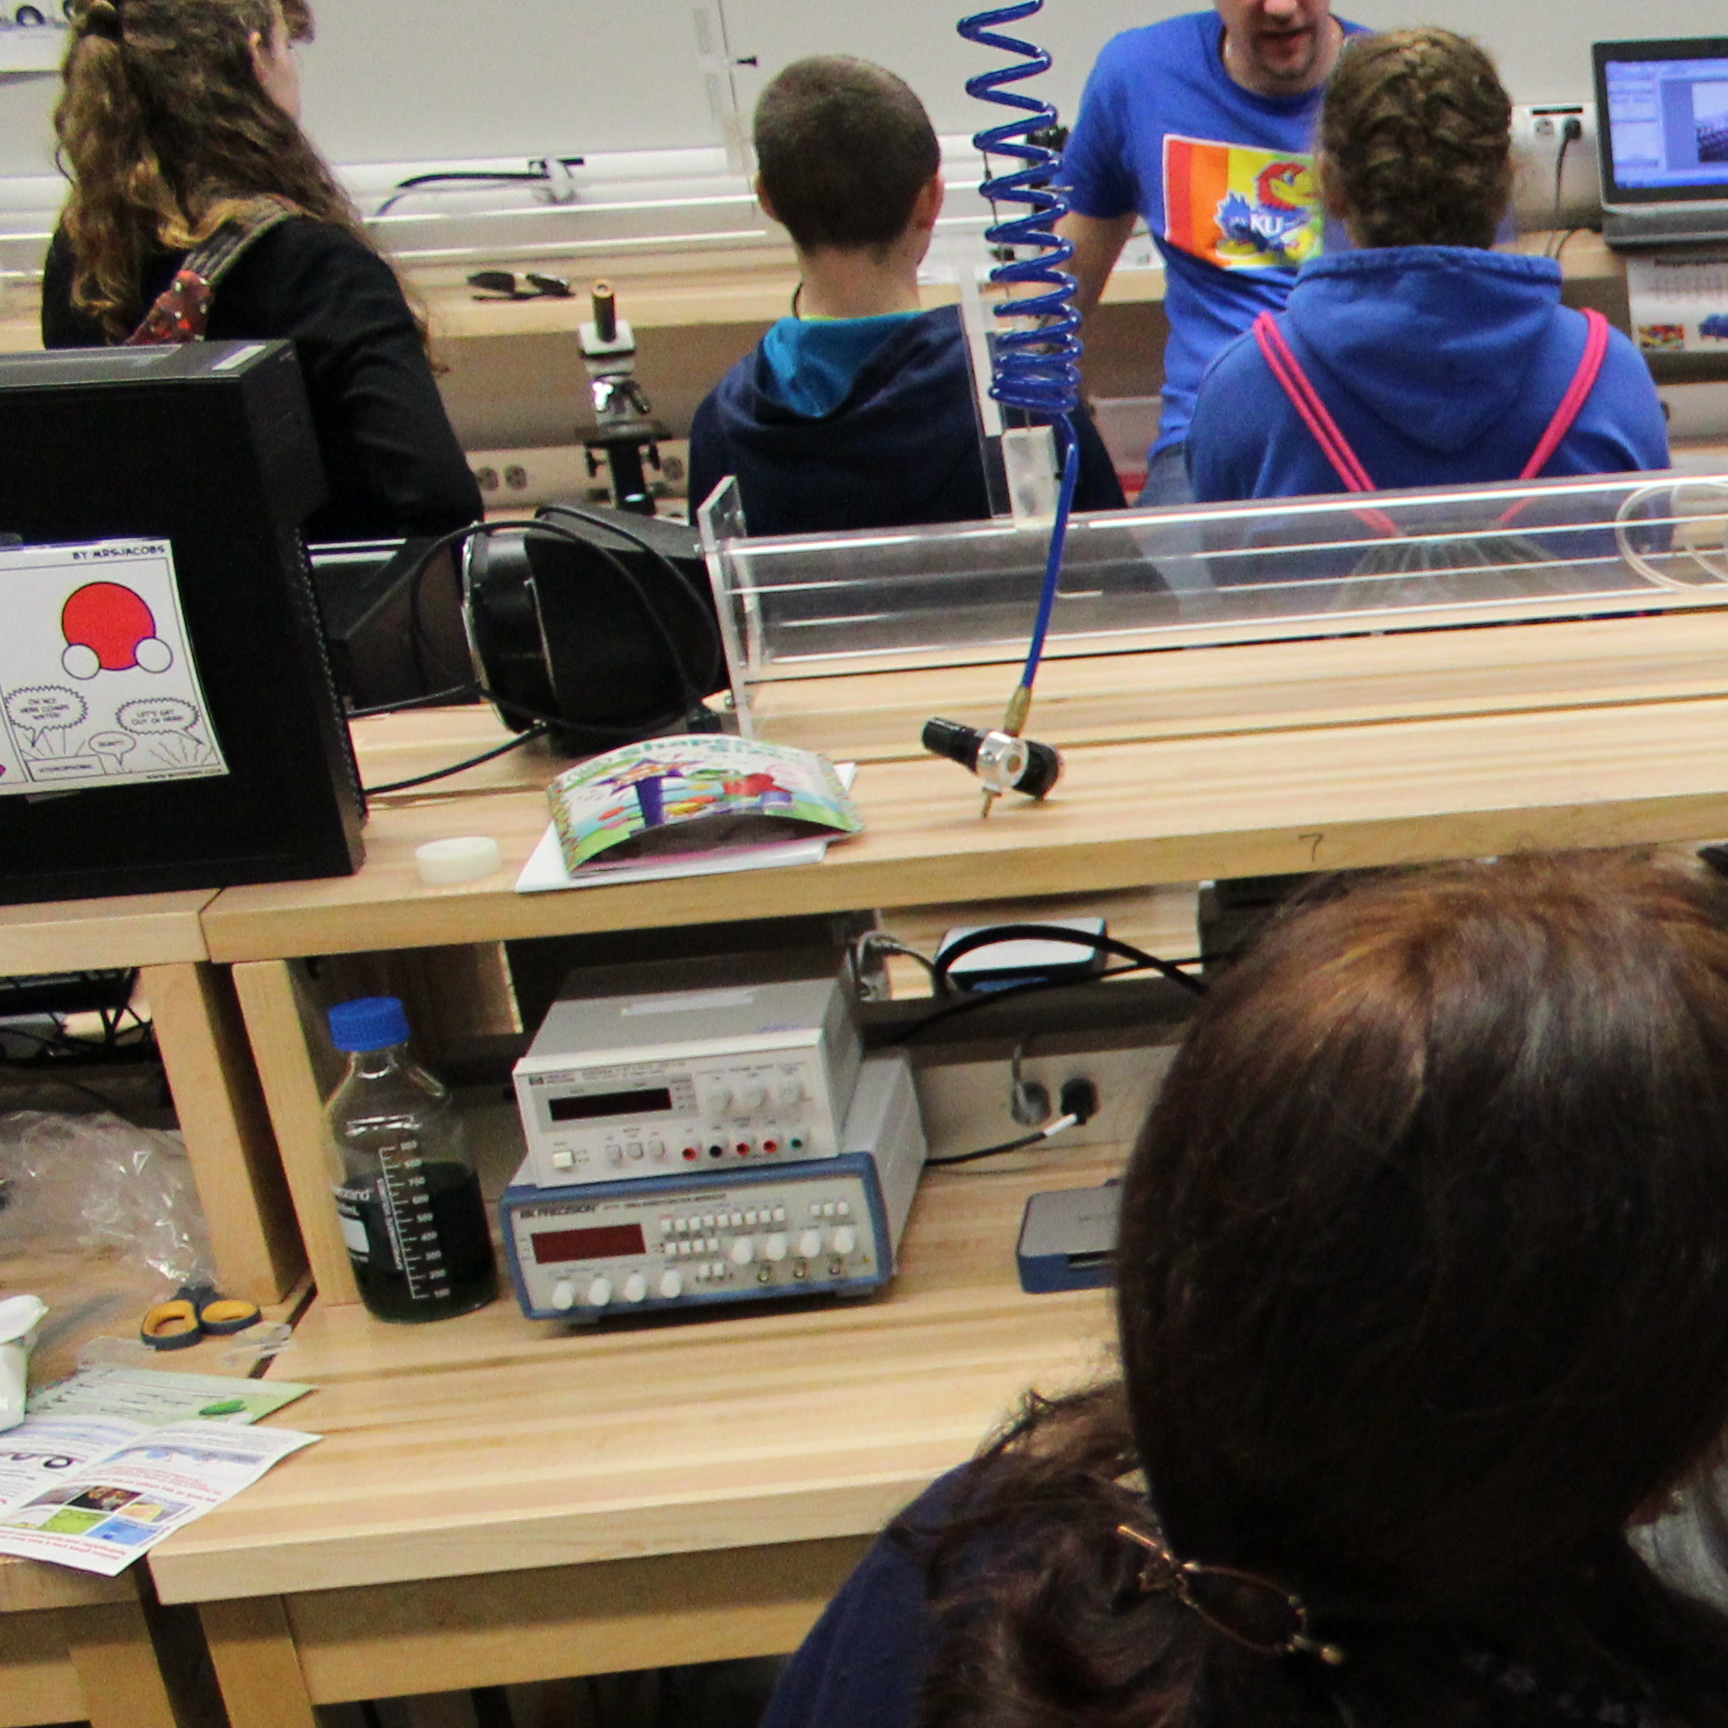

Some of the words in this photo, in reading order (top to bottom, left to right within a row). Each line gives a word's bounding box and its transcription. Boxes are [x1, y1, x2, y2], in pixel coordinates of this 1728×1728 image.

[1250, 213, 1284, 238] KU
[72, 550, 89, 560] BY
[93, 545, 166, 560] MRSJACOBS
[408, 1176, 426, 1187] 700
[429, 1269, 447, 1280] 200
